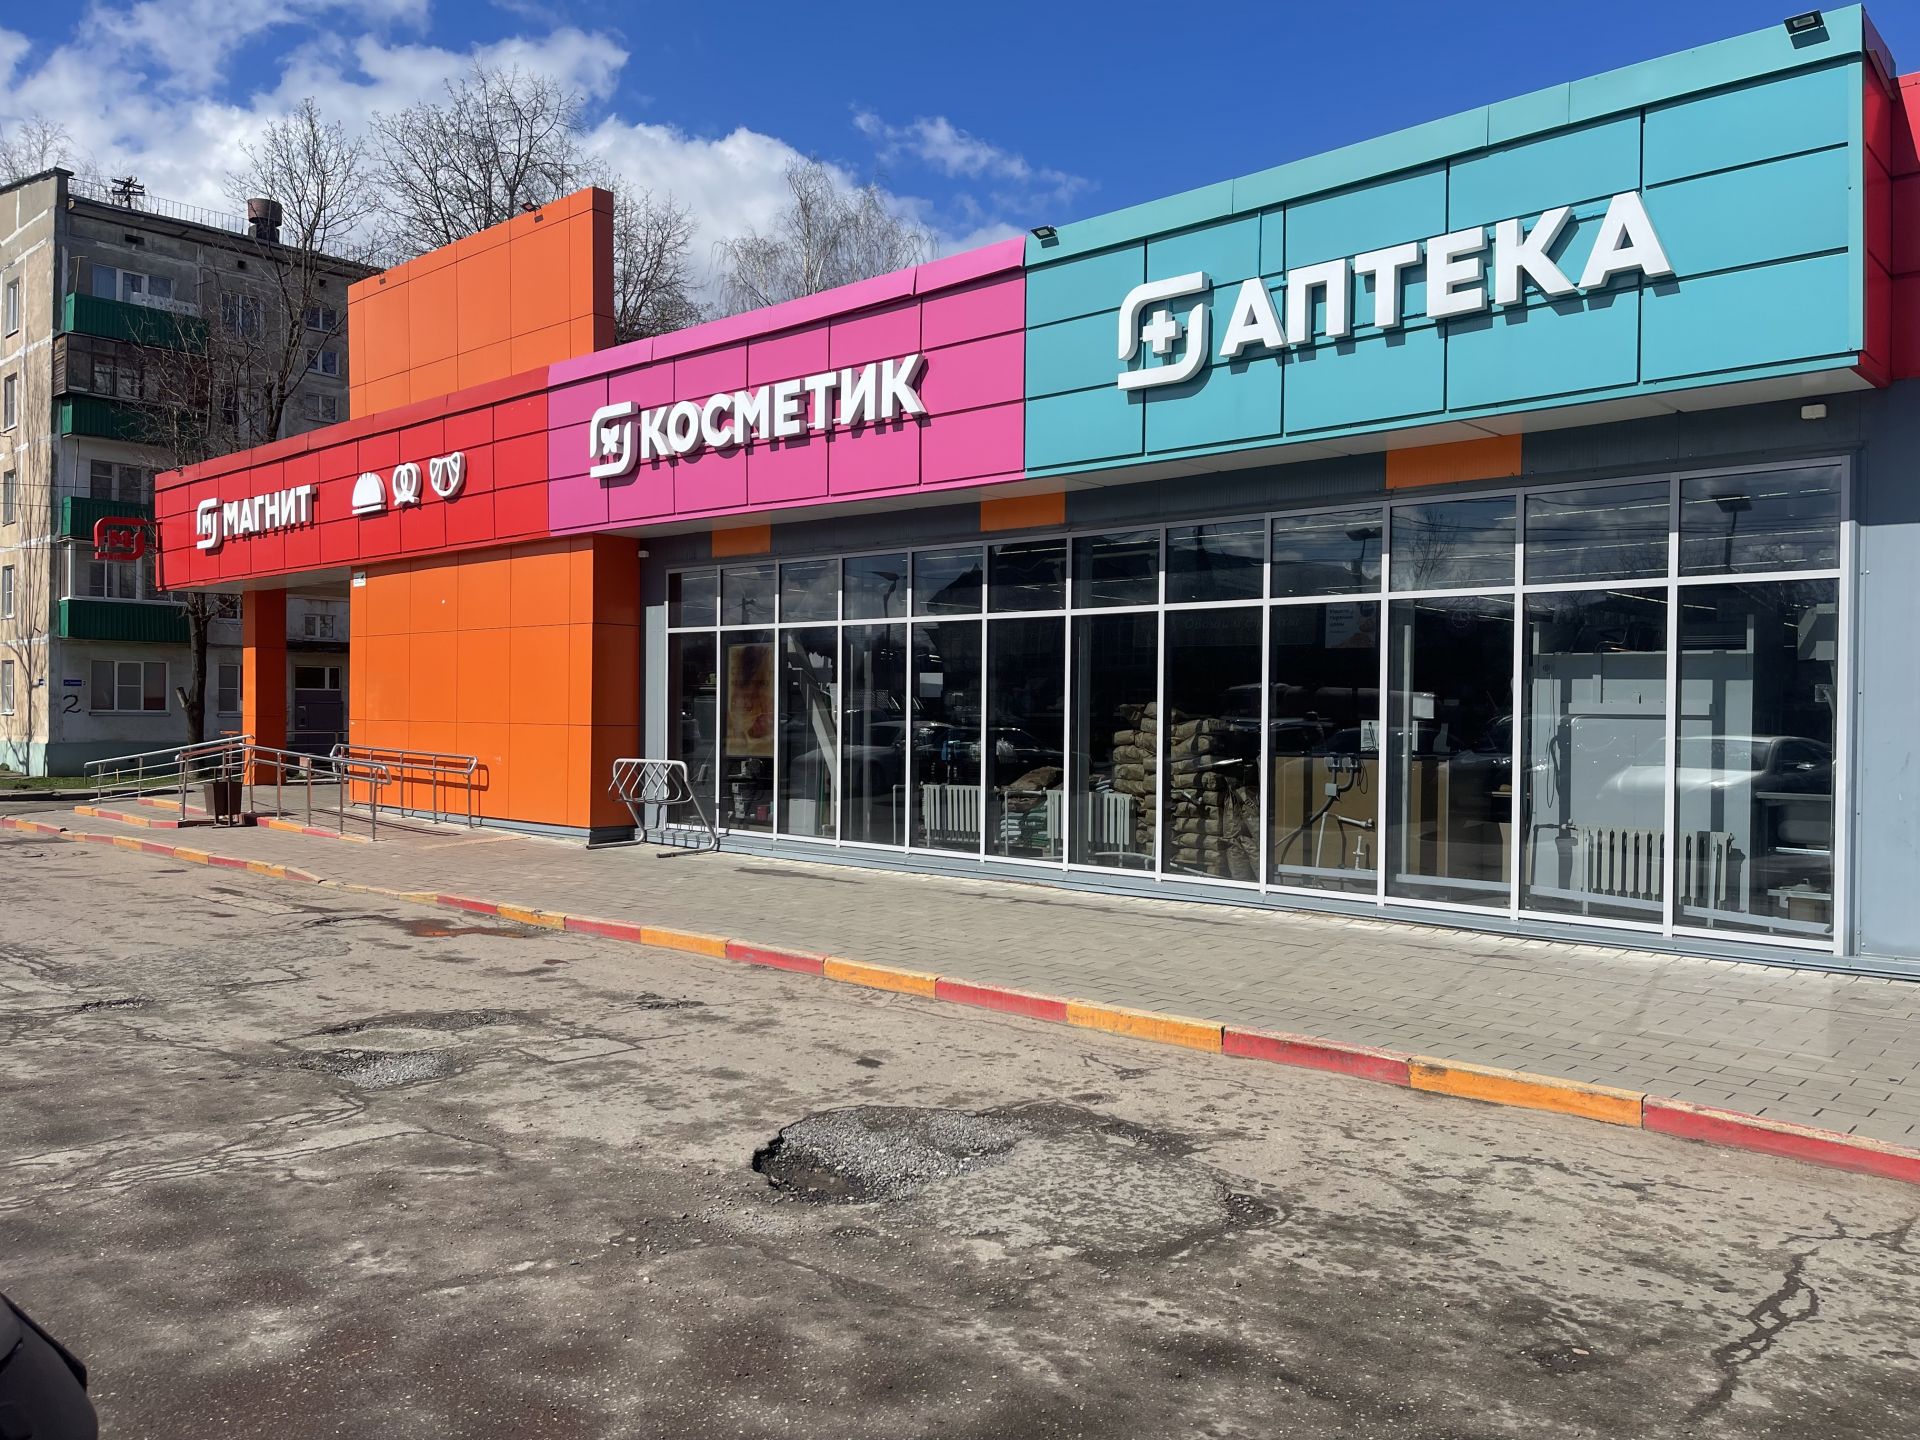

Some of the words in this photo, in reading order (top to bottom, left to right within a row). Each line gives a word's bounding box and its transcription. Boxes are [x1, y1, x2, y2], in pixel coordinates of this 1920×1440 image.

[1218, 190, 1676, 358] АПТЕКА
[640, 354, 928, 460] КОСМЕТИК
[223, 484, 314, 537] МАГНИТ
[63, 694, 82, 714] 2
